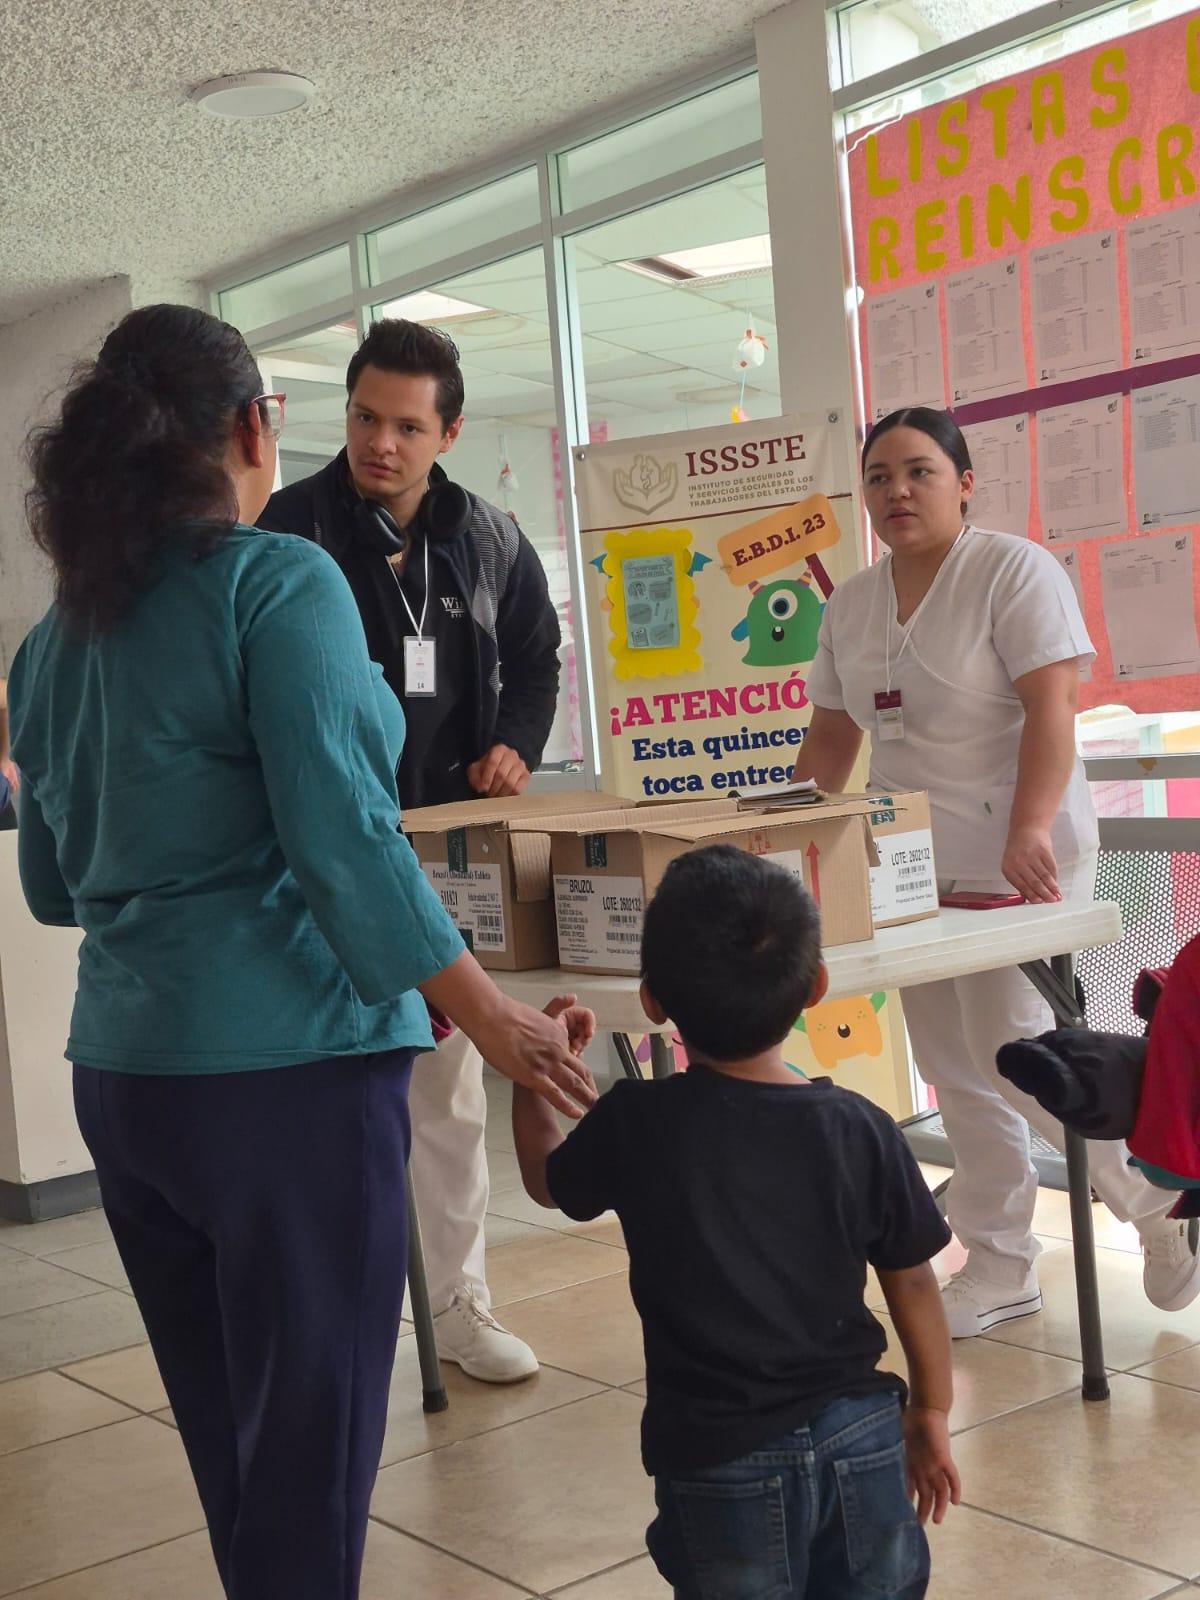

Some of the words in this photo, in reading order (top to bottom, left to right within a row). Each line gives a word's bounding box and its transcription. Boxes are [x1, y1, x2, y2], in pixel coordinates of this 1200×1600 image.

[865, 48, 1129, 197] LISTAS
[868, 123, 1196, 284] REINSCR
[685, 434, 806, 477] ISSSTE
[688, 480, 731, 491] INSTITUTO
[733, 478, 744, 486] DE
[746, 470, 794, 482] SEGURIDAD
[697, 487, 740, 498] SERVICIOS
[742, 481, 782, 492] SOCIALES
[785, 478, 795, 486] DE
[798, 475, 814, 483] LOS
[690, 492, 754, 507] TRABAJADORES
[775, 484, 808, 495] ESTADO
[732, 527, 801, 566] E.B.D.I.
[803, 513, 826, 535] 23
[609, 671, 809, 736] ¡ATENCIÓ
[632, 737, 695, 761] Esta
[642, 774, 704, 796] toca
[891, 852, 907, 866] LOTE:
[603, 897, 619, 911] LOTE:
